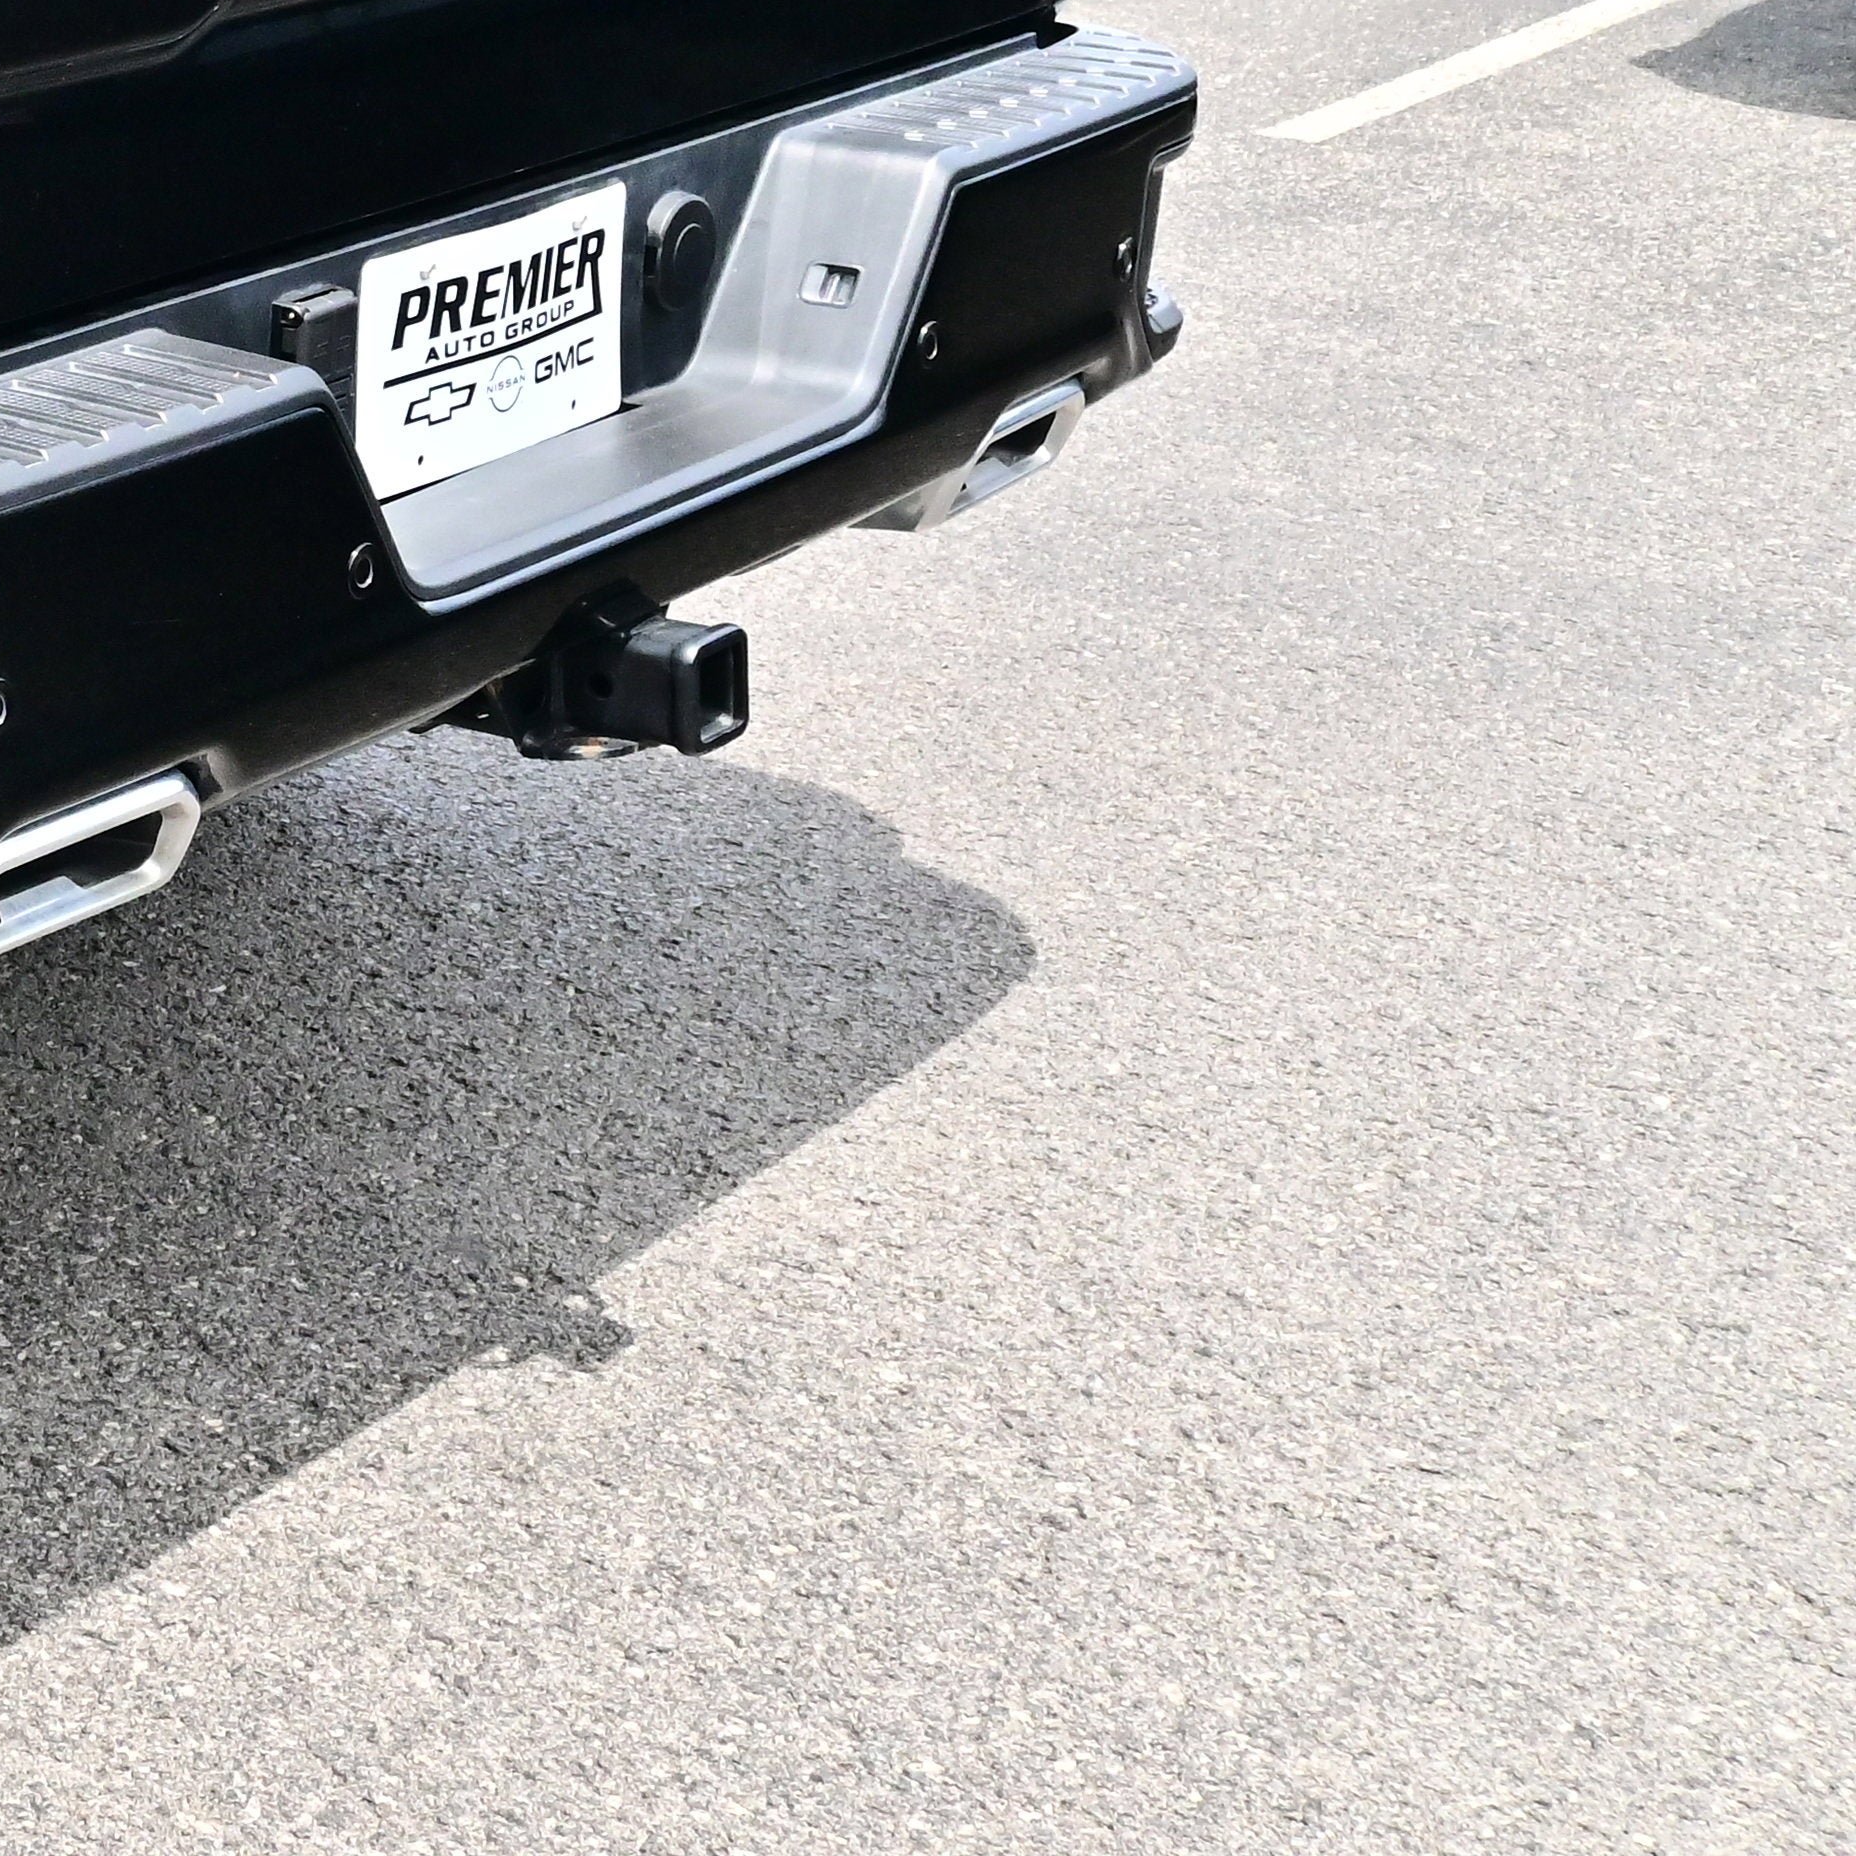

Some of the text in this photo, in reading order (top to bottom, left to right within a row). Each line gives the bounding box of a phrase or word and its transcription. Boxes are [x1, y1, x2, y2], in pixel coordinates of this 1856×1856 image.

[390, 227, 606, 352] PREMIER
[424, 299, 576, 365] AUTO GROUP
[485, 336, 595, 395] NISSAN GMC
